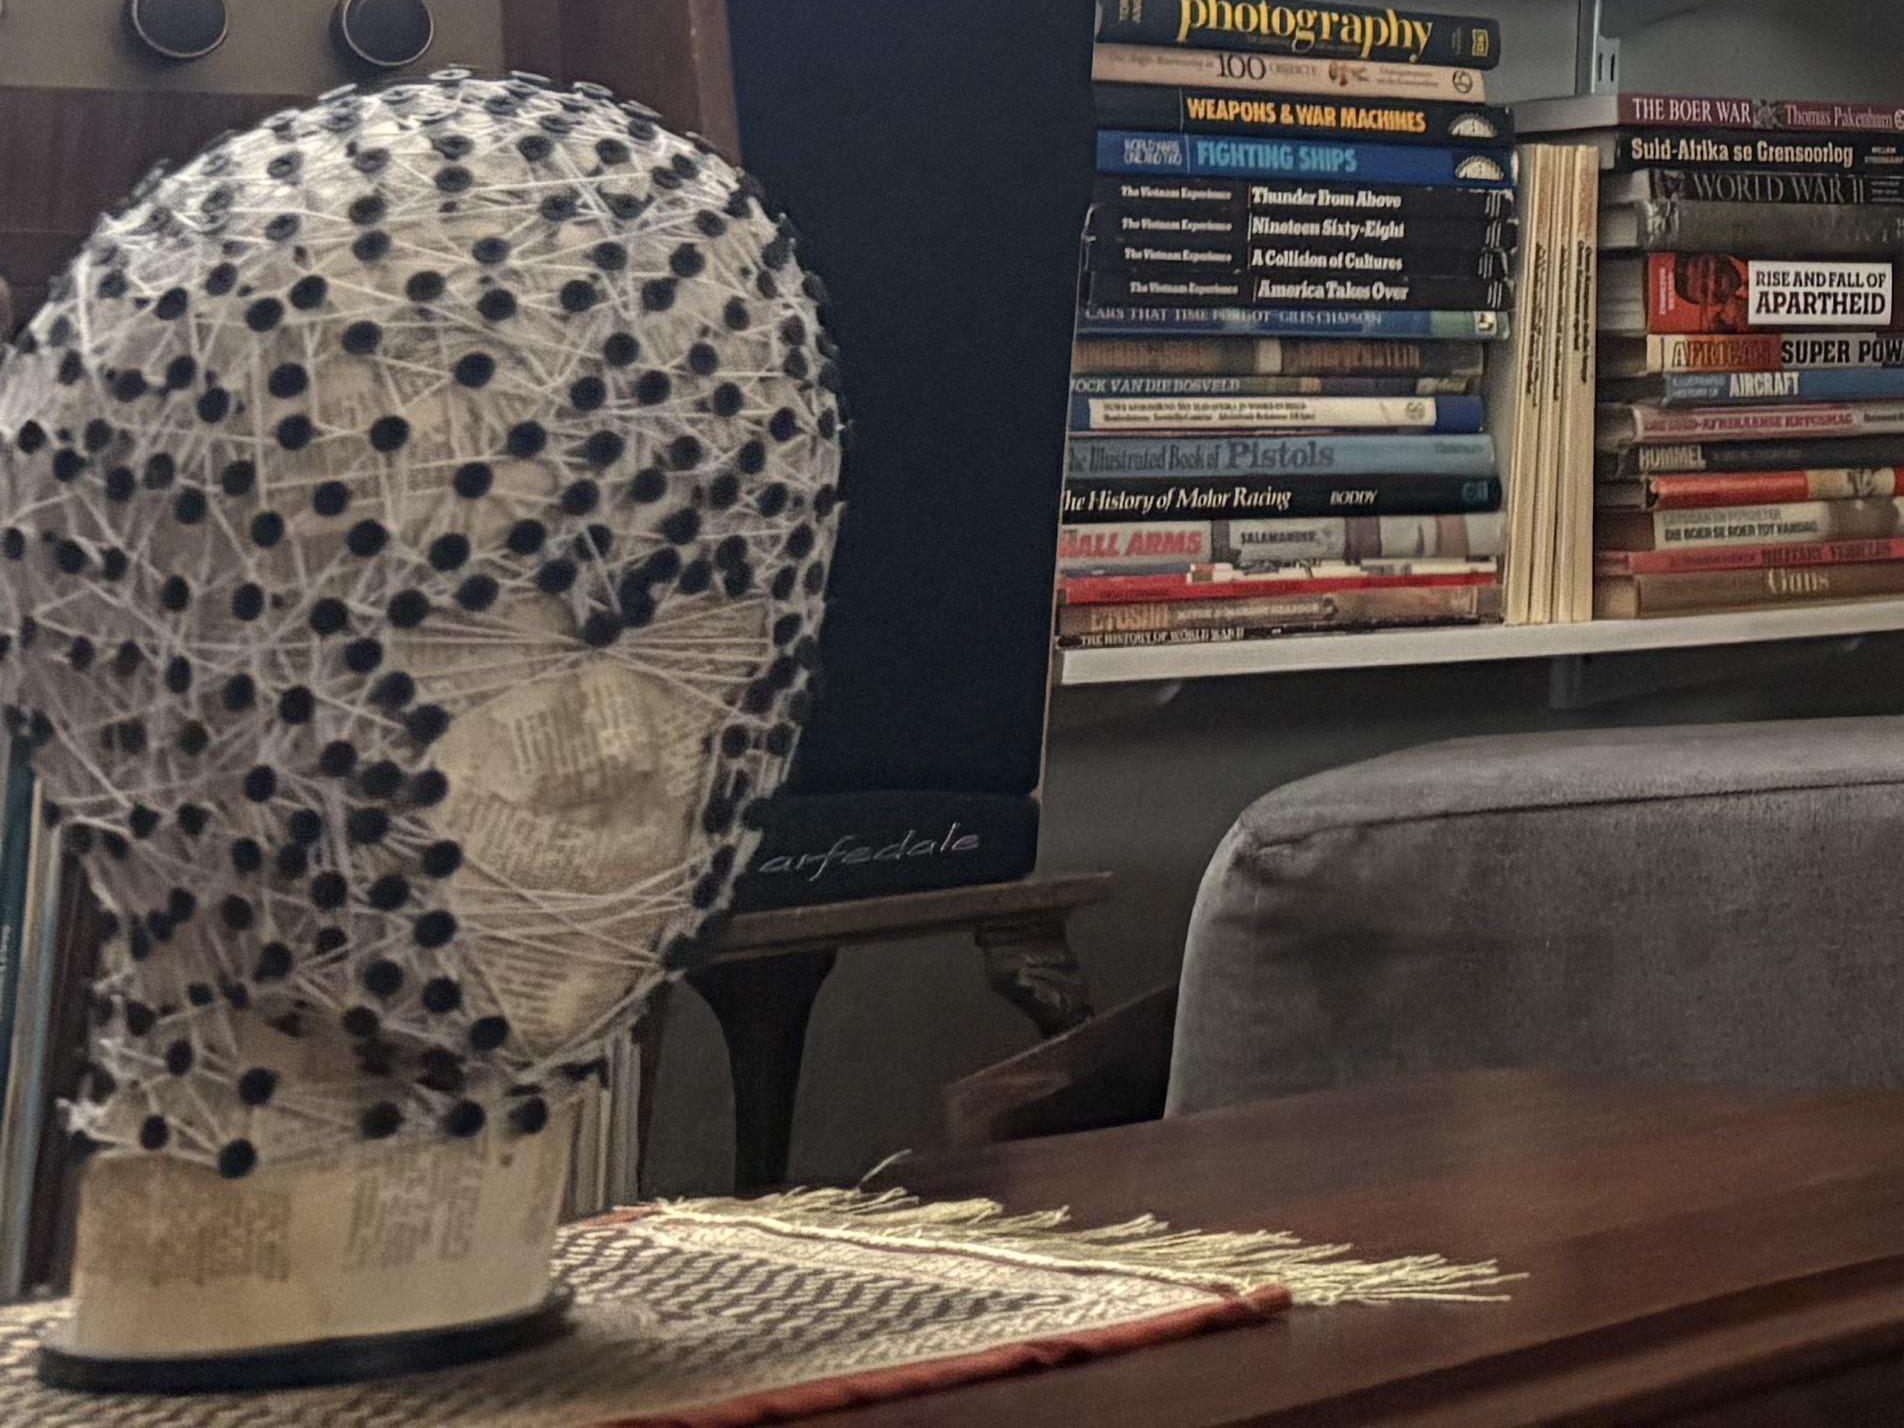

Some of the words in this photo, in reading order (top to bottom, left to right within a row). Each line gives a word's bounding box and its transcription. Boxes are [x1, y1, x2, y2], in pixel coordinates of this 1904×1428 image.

[1216, 54, 1266, 80] 100
[1187, 97, 1277, 124] WEAPONS
[1280, 105, 1294, 125] &
[1296, 104, 1337, 128] WAR
[1341, 108, 1427, 133] MACHINES
[1632, 97, 1661, 122] THE
[1663, 98, 1713, 124] BOER
[1715, 101, 1752, 125] WAR
[1197, 140, 1294, 171] FIGHTING
[1299, 148, 1357, 173] SHIPS
[1631, 138, 1730, 163] Suid-Afrika
[1732, 144, 1753, 162] se
[1756, 139, 1855, 169] Grensoorlog
[1756, 271, 1791, 289] RISE
[1793, 271, 1827, 289] AND
[1829, 272, 1861, 289] FALL
[1866, 272, 1887, 290] OF
[1756, 292, 1887, 317] APARTHEID
[1782, 339, 1851, 366] SUPER
[758, 822, 981, 883] arfedale
